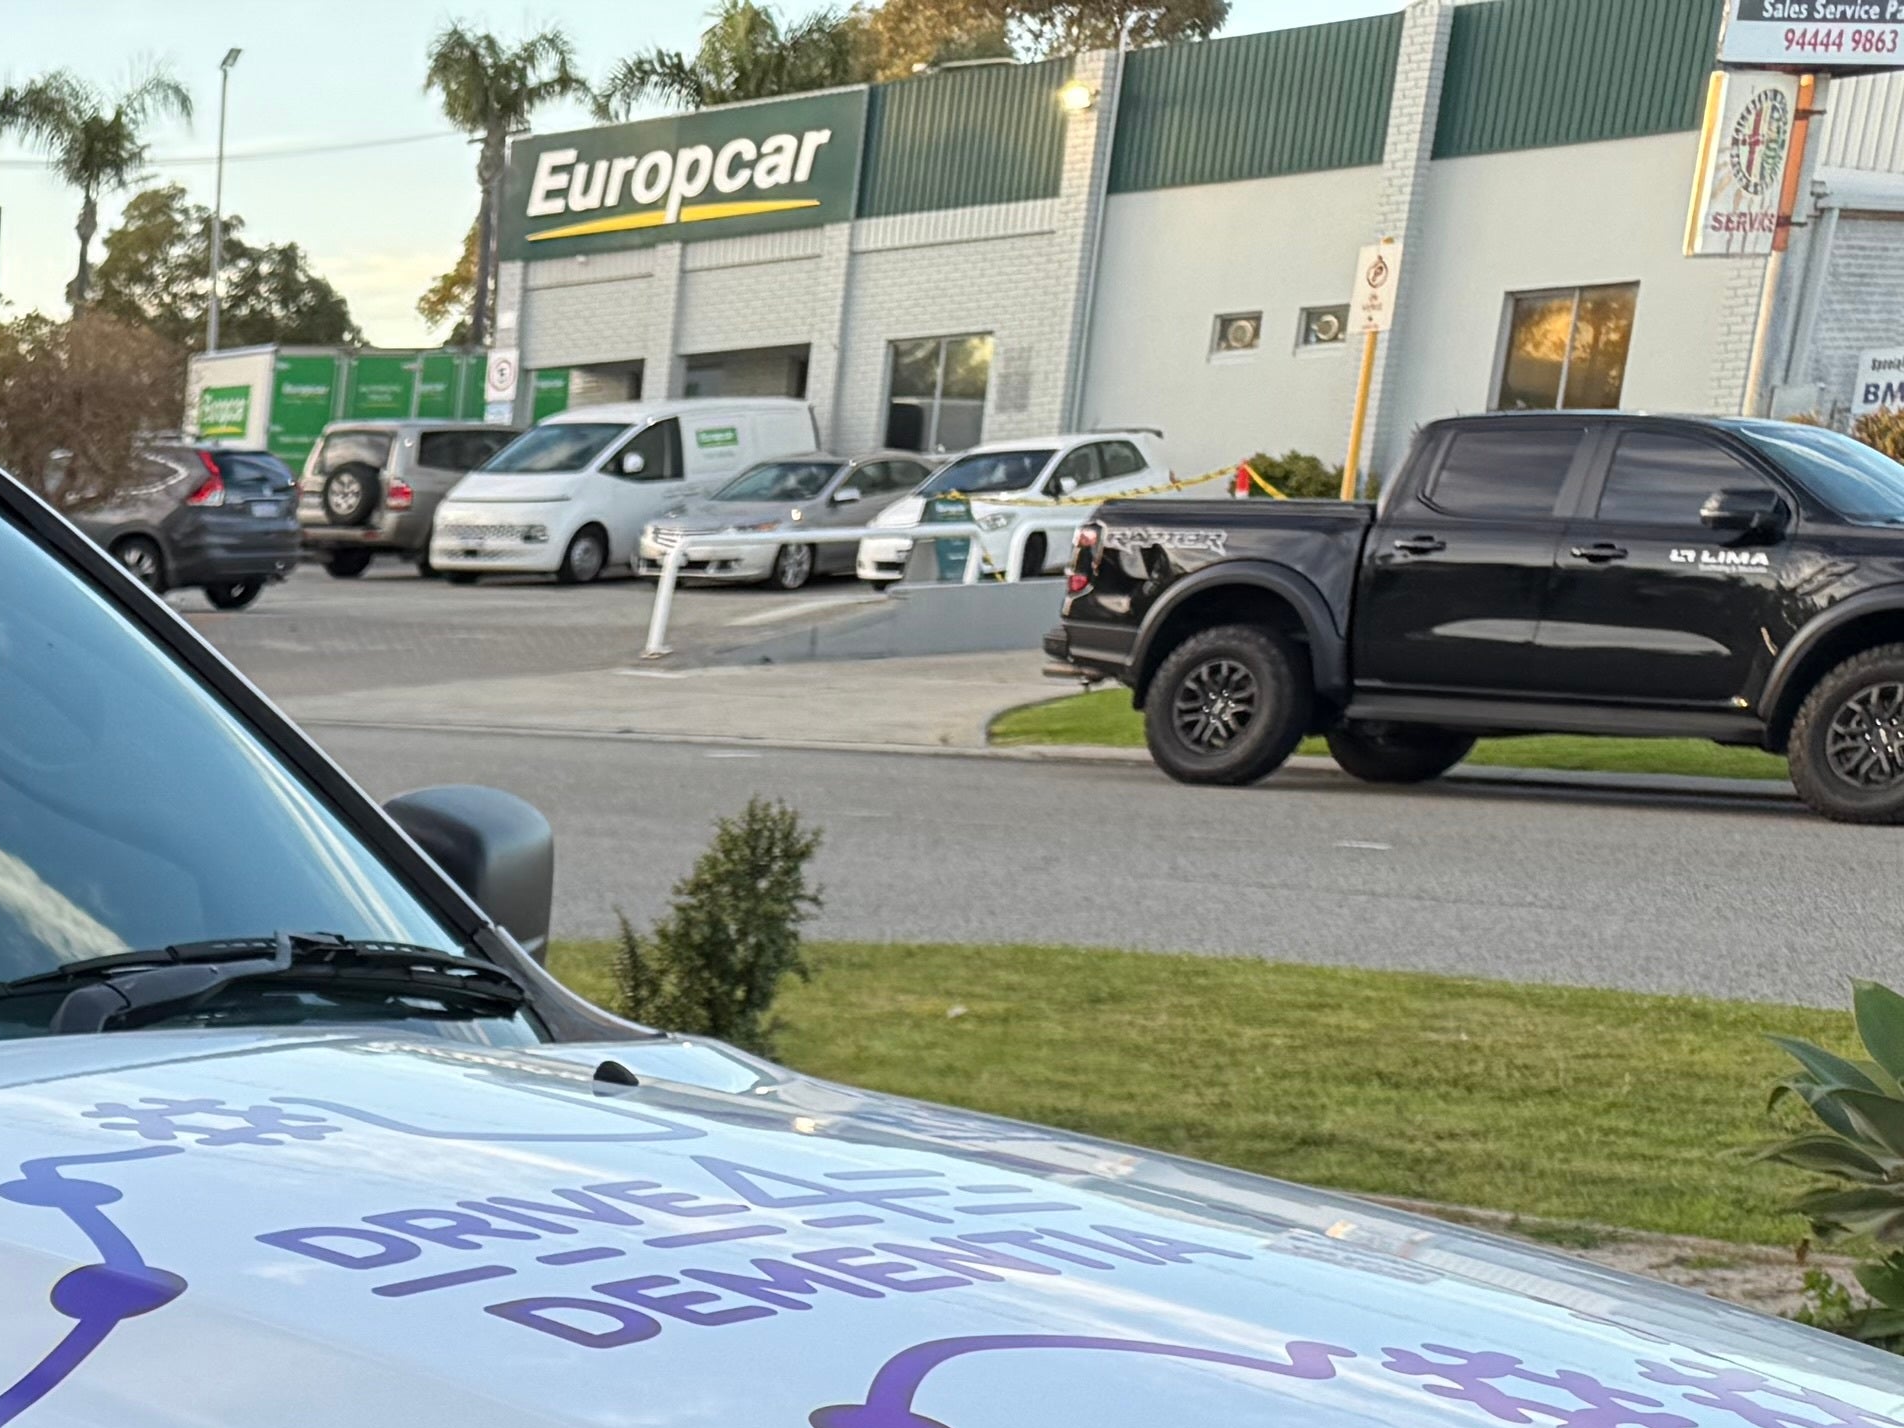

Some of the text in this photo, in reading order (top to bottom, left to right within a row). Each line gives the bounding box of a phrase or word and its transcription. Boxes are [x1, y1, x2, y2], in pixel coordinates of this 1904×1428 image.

[1762, 0, 1808, 19] Sales
[1814, 0, 1880, 20] Service
[1784, 28, 1899, 53] 94444 9863
[526, 128, 832, 224] Europcar
[1700, 550, 1770, 565] LIMA
[482, 1221, 1253, 1349] DEMENTIA
